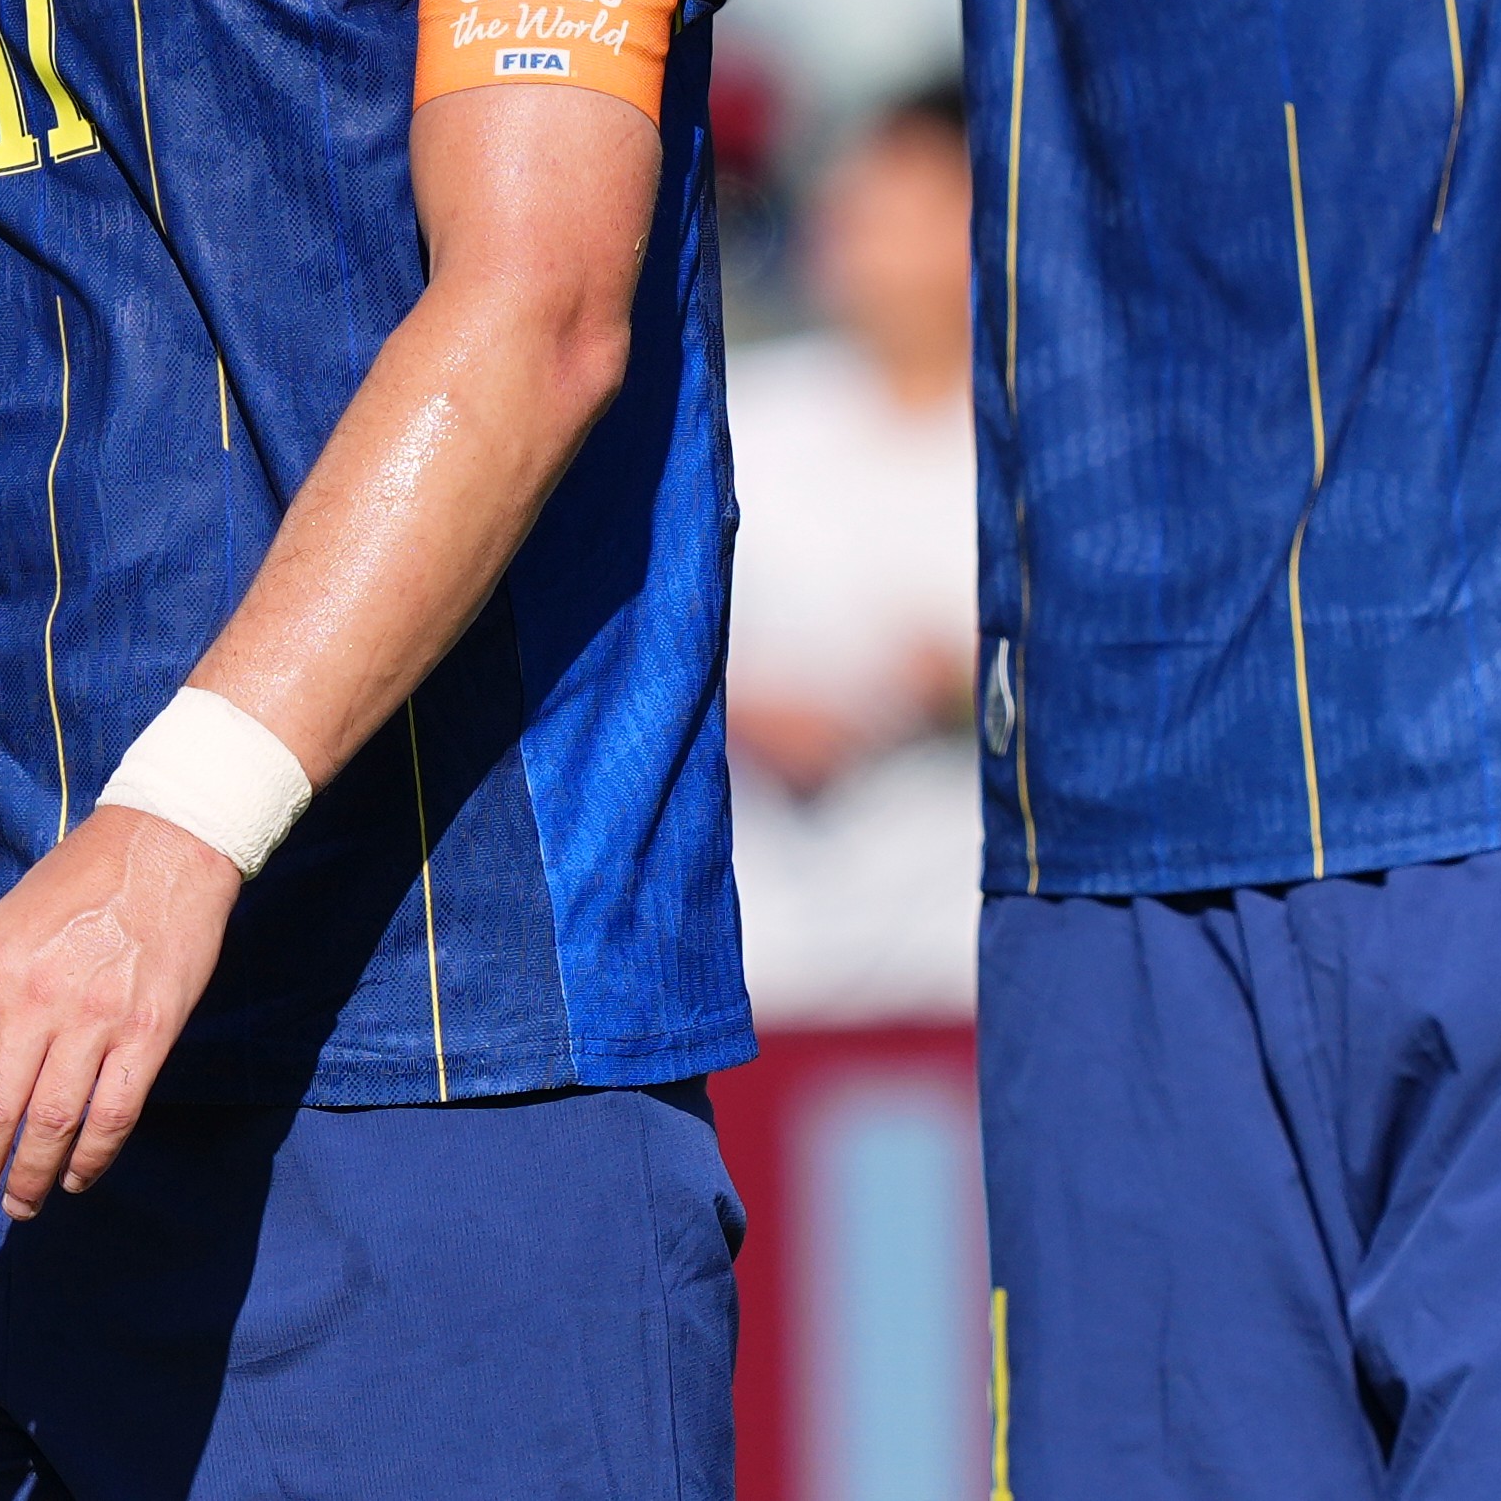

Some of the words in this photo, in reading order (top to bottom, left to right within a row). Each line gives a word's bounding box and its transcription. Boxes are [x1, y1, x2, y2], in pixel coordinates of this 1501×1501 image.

[449, 6, 508, 49] the
[515, 3, 630, 56] World
[502, 53, 564, 71] FIFA
